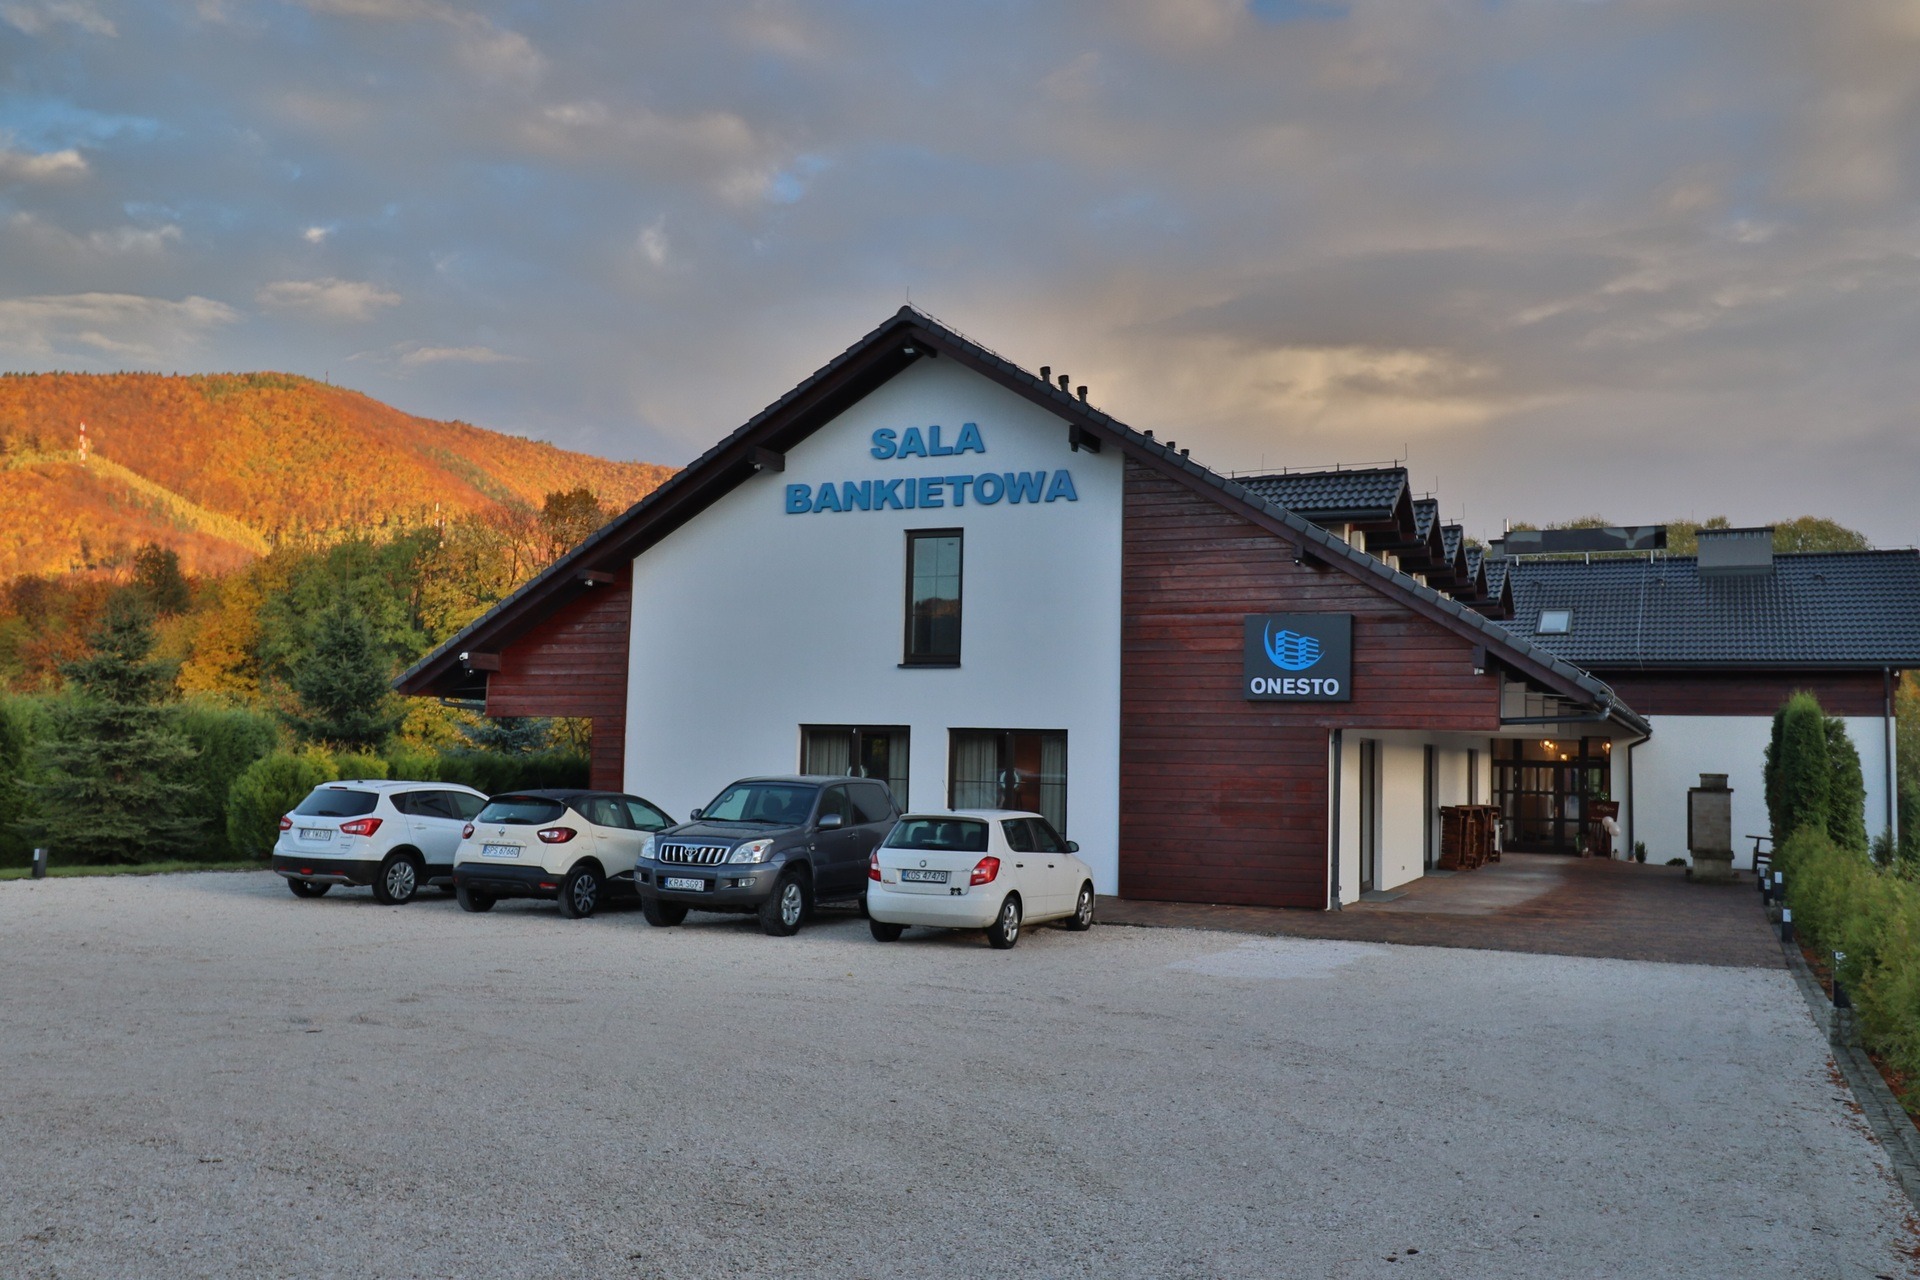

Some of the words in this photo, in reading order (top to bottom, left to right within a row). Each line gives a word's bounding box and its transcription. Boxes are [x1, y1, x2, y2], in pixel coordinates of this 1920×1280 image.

[870, 422, 986, 460] SALA
[785, 469, 1078, 514] BANKIETOWA
[1250, 677, 1340, 696] ONESTO
[486, 846, 498, 854] SPS
[906, 870, 920, 880] KOS
[922, 871, 945, 881] 47478
[668, 878, 684, 887] KRA
[685, 879, 703, 889] SG93
